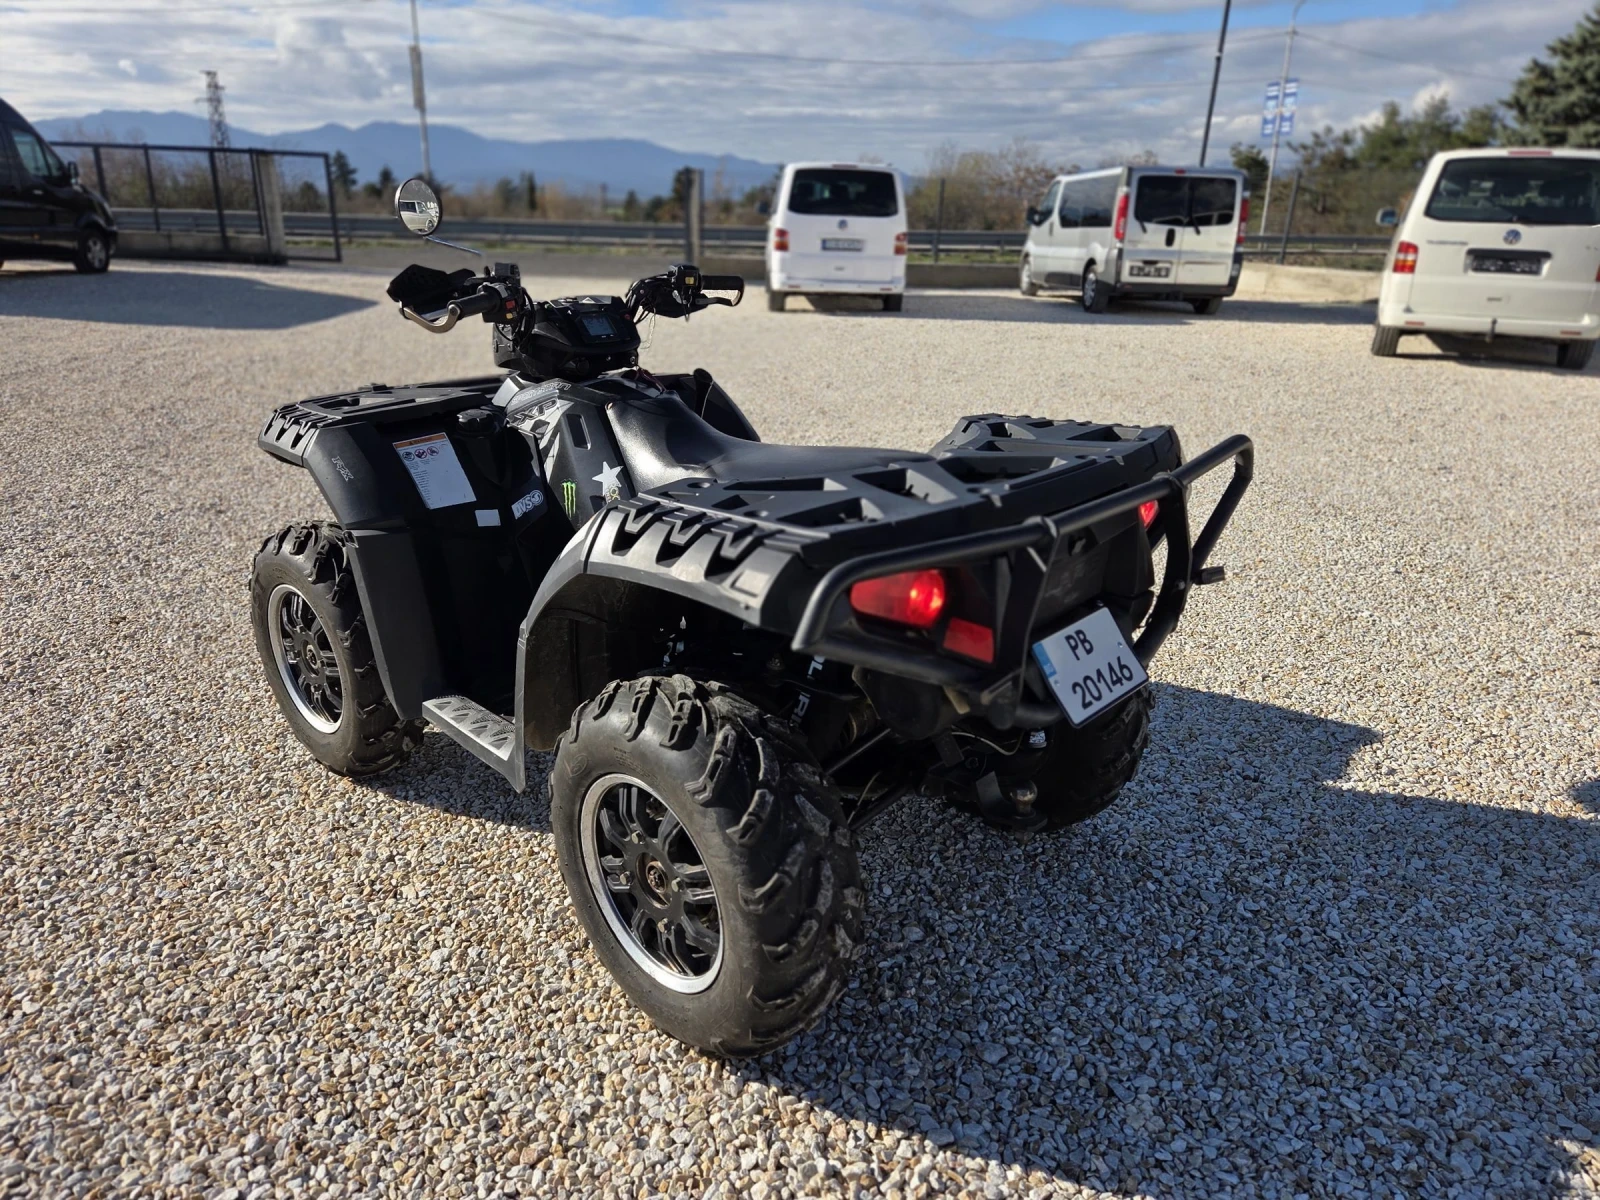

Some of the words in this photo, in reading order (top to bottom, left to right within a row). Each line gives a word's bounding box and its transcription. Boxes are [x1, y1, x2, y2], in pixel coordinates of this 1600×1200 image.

[513, 398, 559, 426] XP
[512, 497, 535, 519] DVS
[1064, 629, 1094, 661] PB
[1071, 655, 1134, 710] 20146
